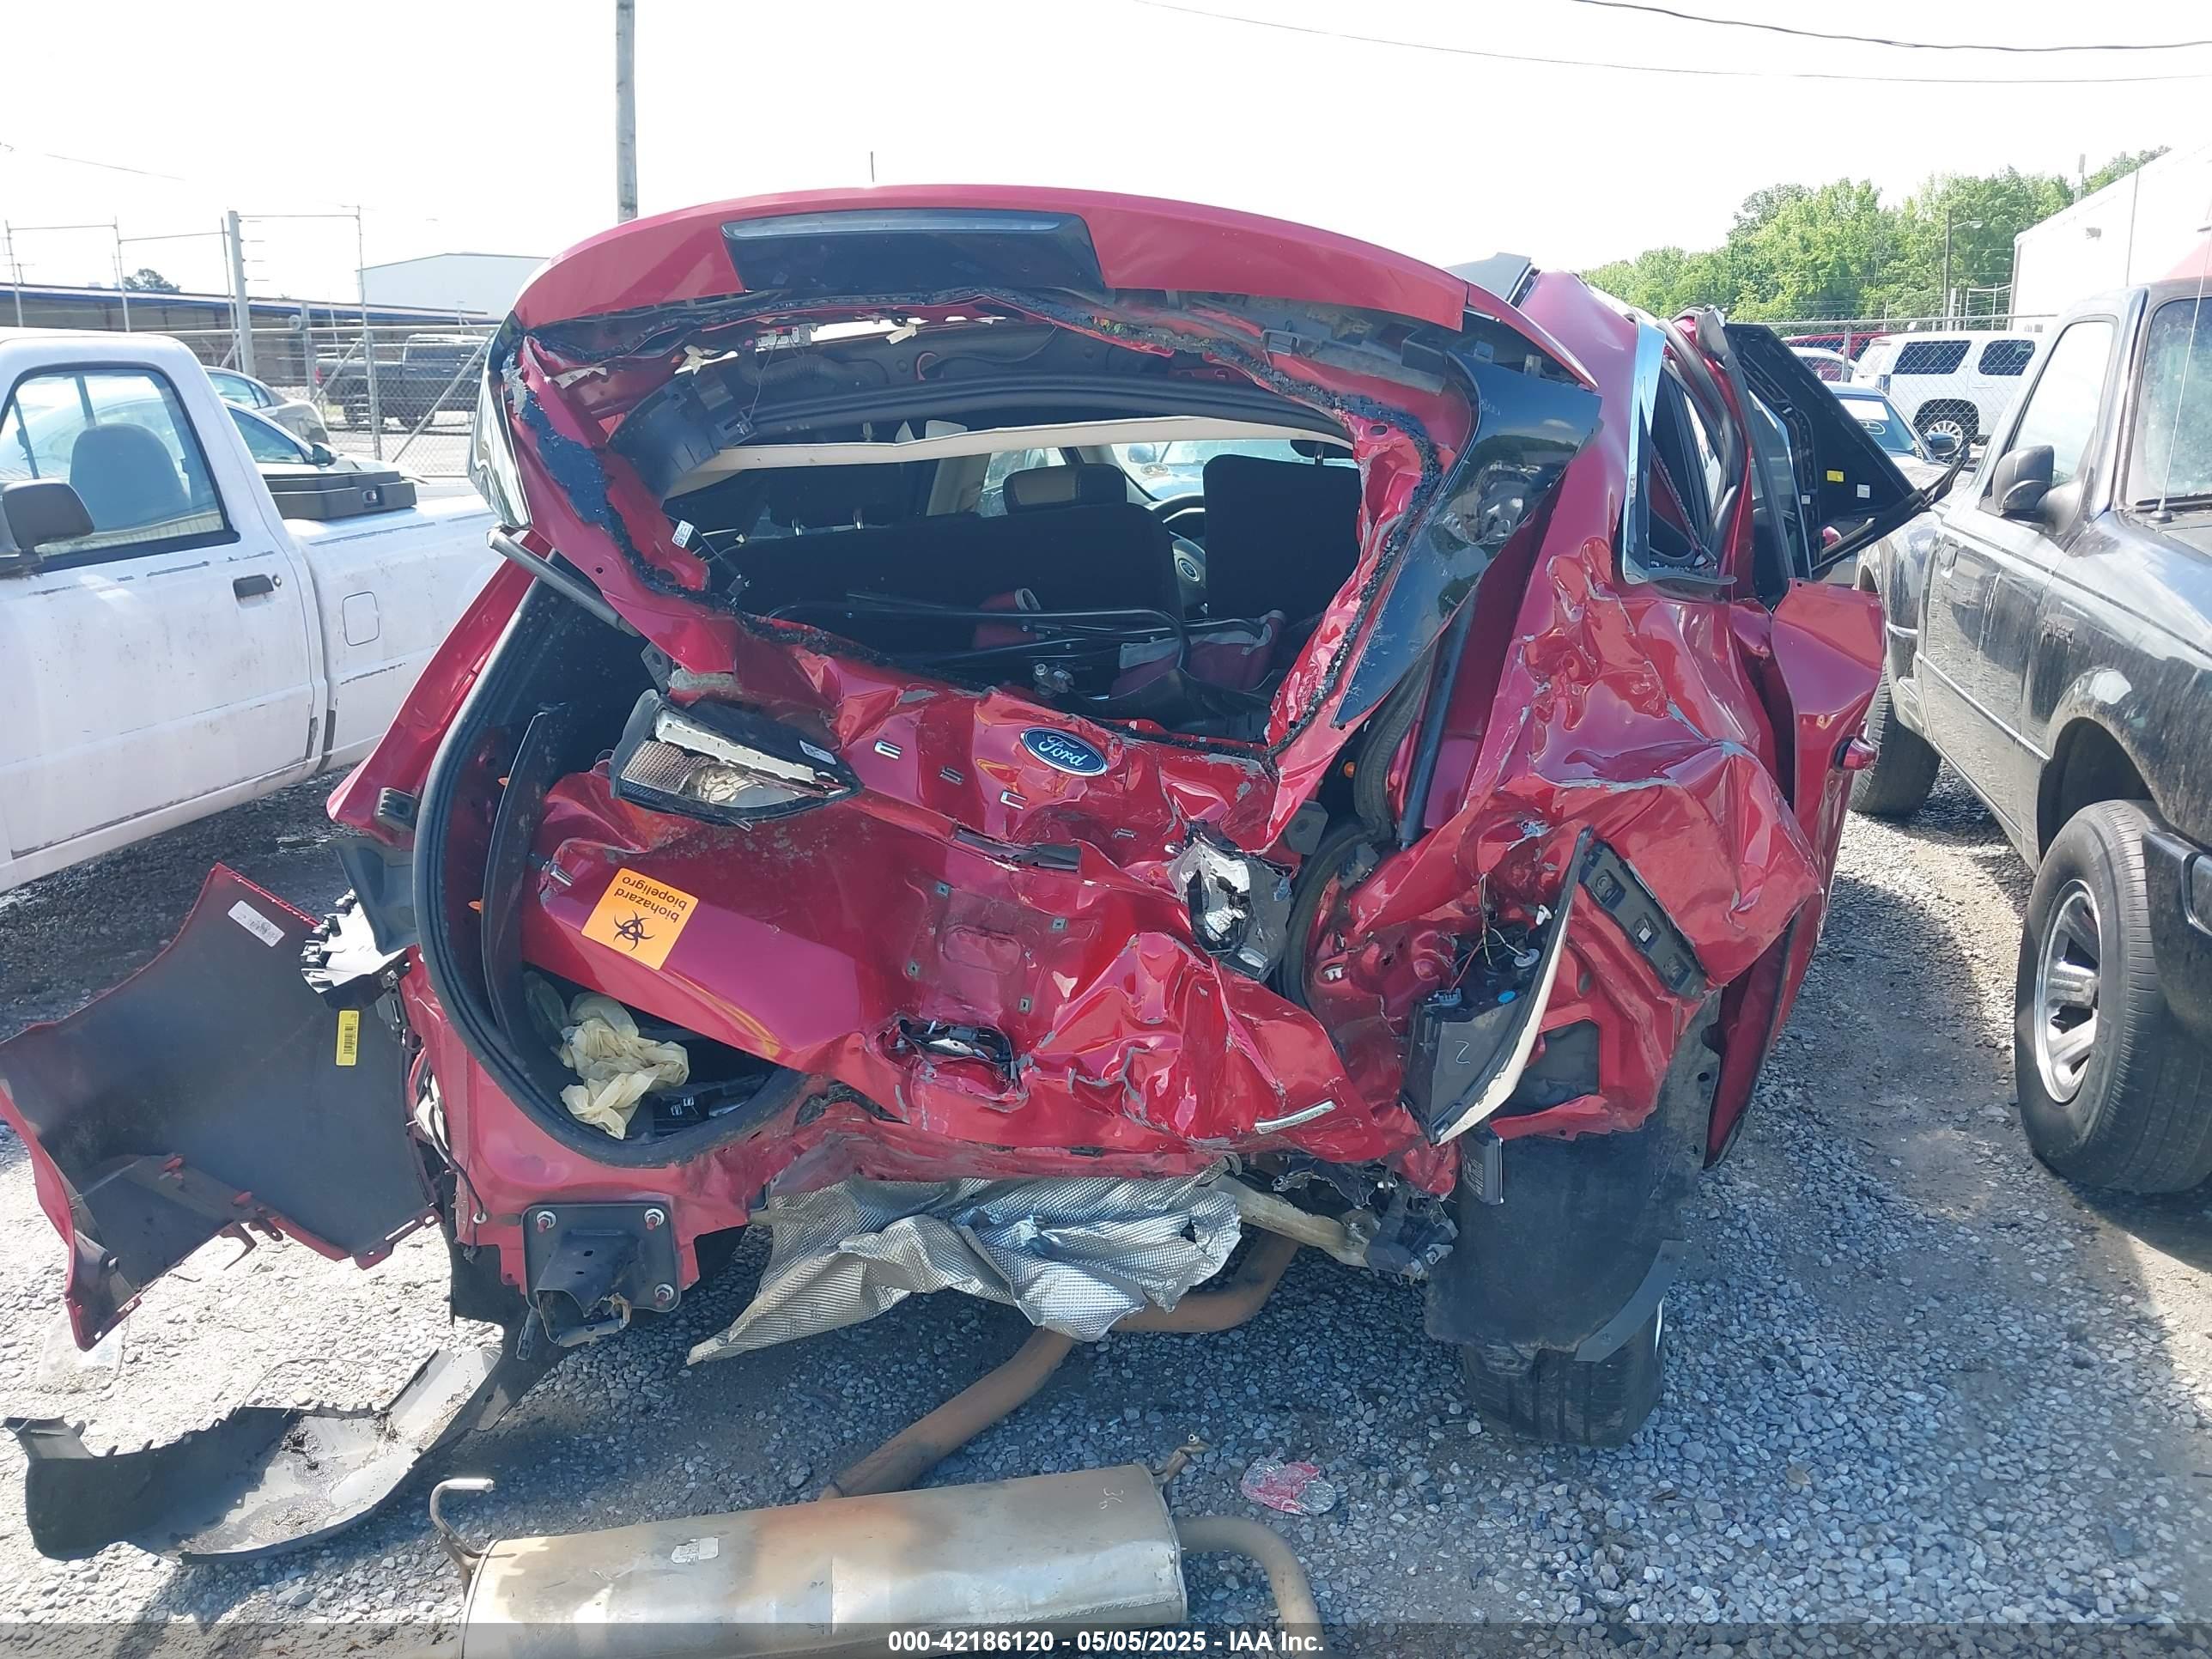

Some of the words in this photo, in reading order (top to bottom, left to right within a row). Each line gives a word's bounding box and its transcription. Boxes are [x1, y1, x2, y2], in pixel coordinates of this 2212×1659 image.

[1038, 735, 1088, 767] Ford
[614, 887, 680, 923] biohazard
[622, 876, 688, 911] biopeligro
